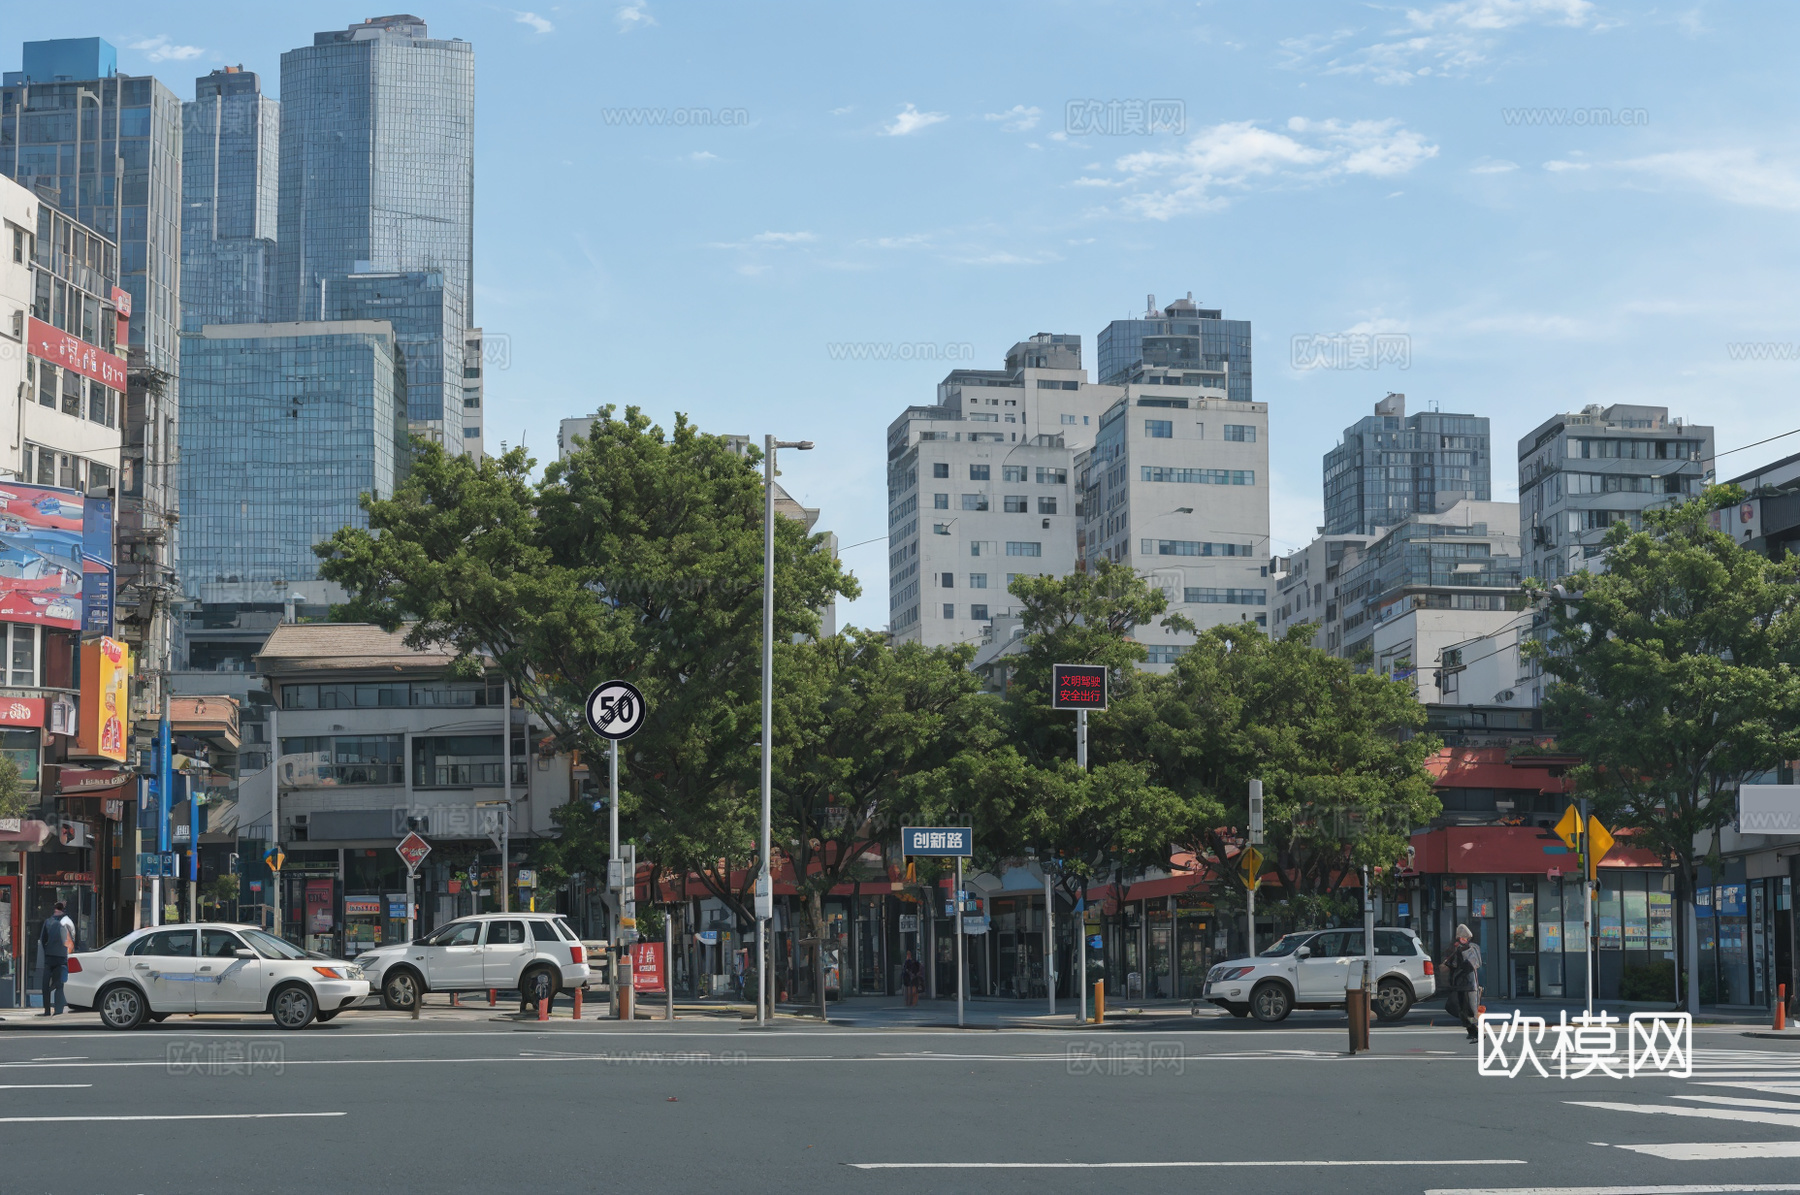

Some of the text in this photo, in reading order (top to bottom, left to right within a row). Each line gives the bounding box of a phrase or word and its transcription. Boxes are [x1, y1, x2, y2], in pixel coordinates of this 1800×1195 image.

[1060, 675, 1101, 687] 文明驾驶
[1060, 689, 1101, 702] 安全出行
[600, 696, 634, 723] 50
[913, 832, 963, 849] 创新路
